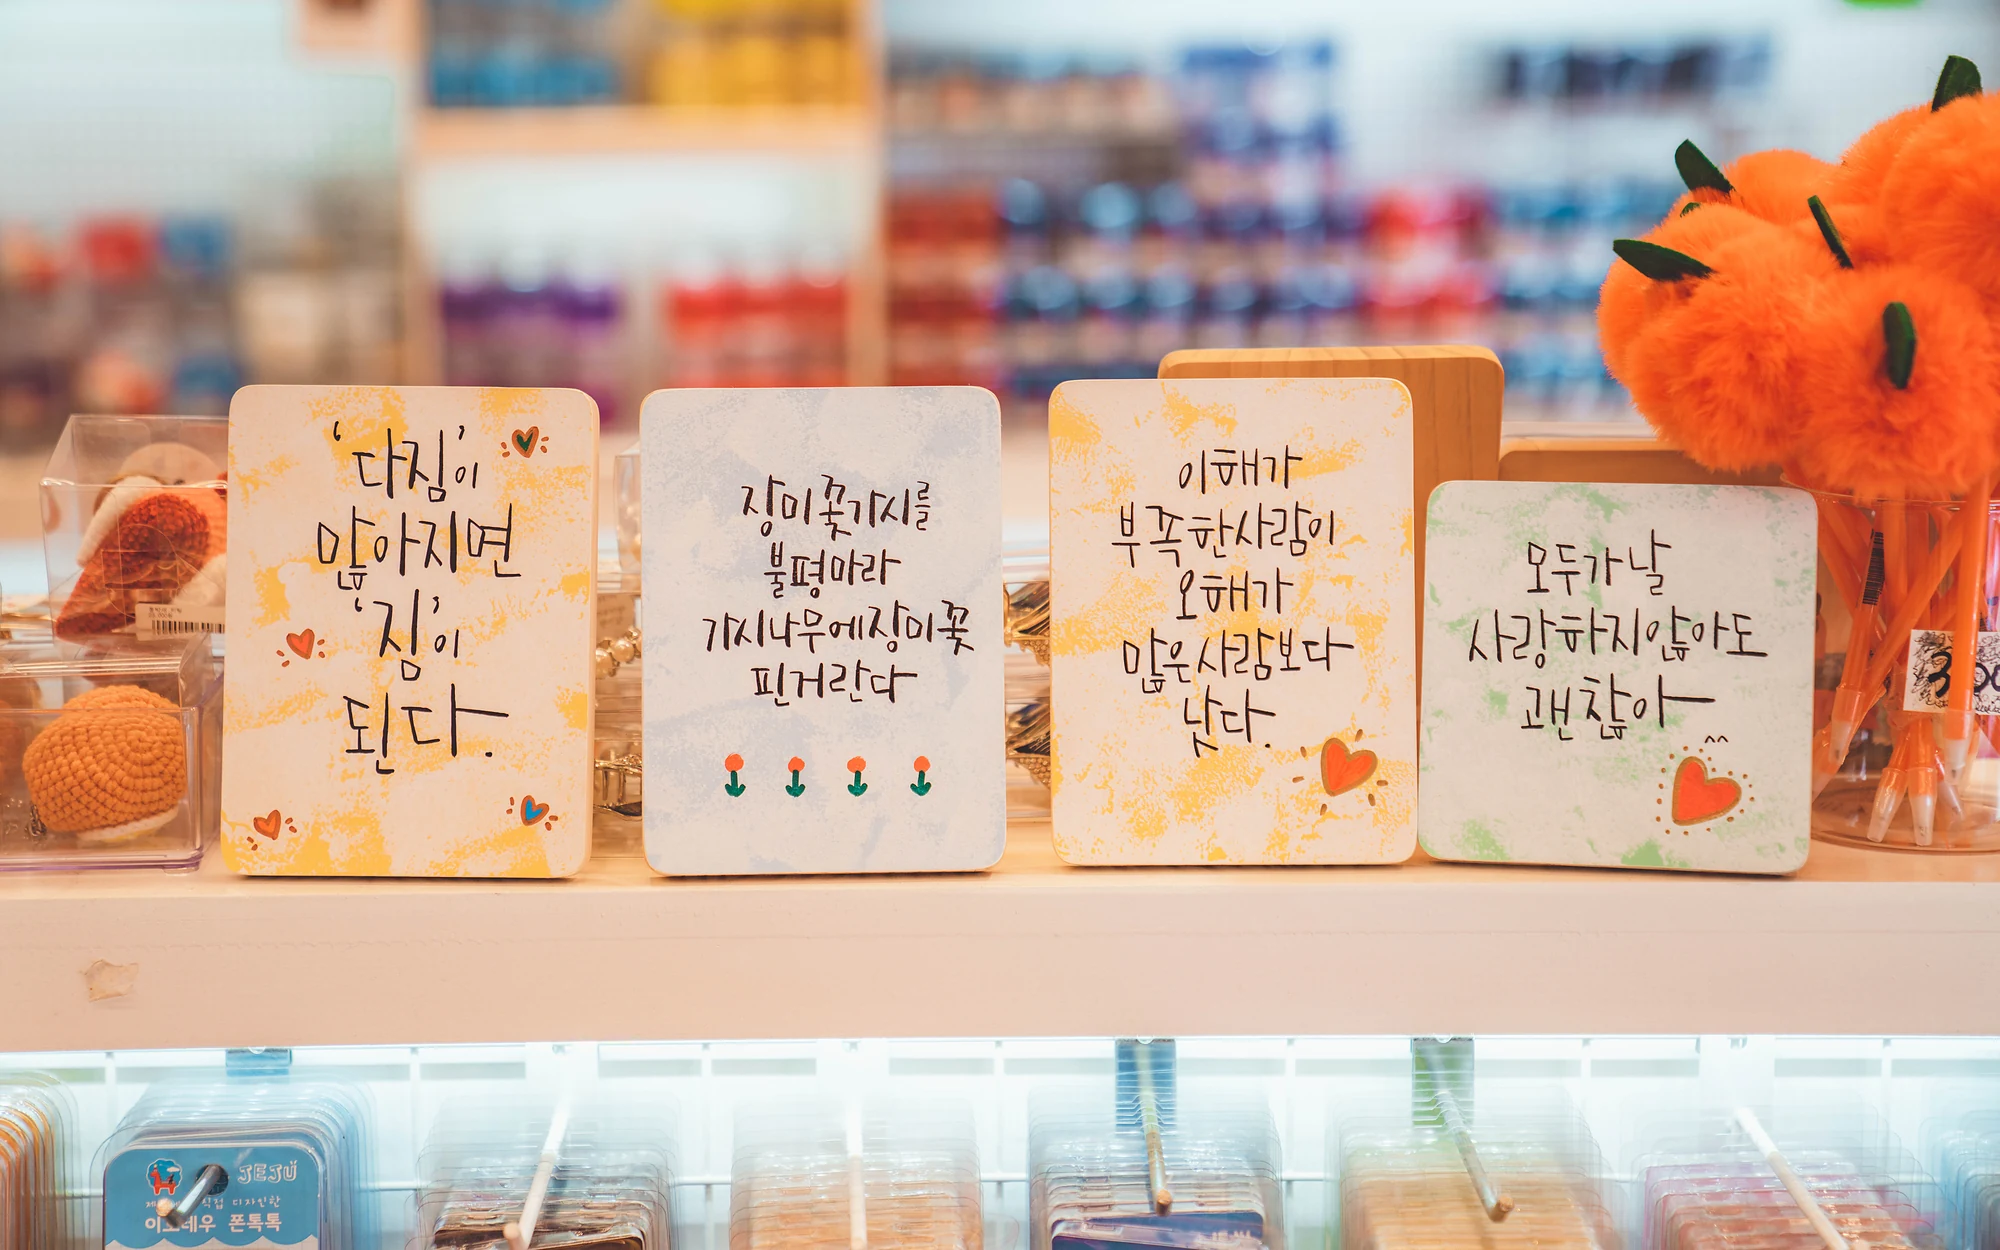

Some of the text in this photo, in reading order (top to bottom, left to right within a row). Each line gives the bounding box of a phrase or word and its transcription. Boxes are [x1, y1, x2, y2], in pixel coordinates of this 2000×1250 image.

[1179, 445, 1303, 495] 이해가
[317, 503, 522, 591] 많아지면
[1175, 567, 1294, 620] 오해가
[342, 683, 510, 775] 된다.
[1520, 673, 1716, 741] 괜찮아
[228, 1213, 282, 1232] 폰톡톡
[232, 1196, 281, 1208] 디자인한
